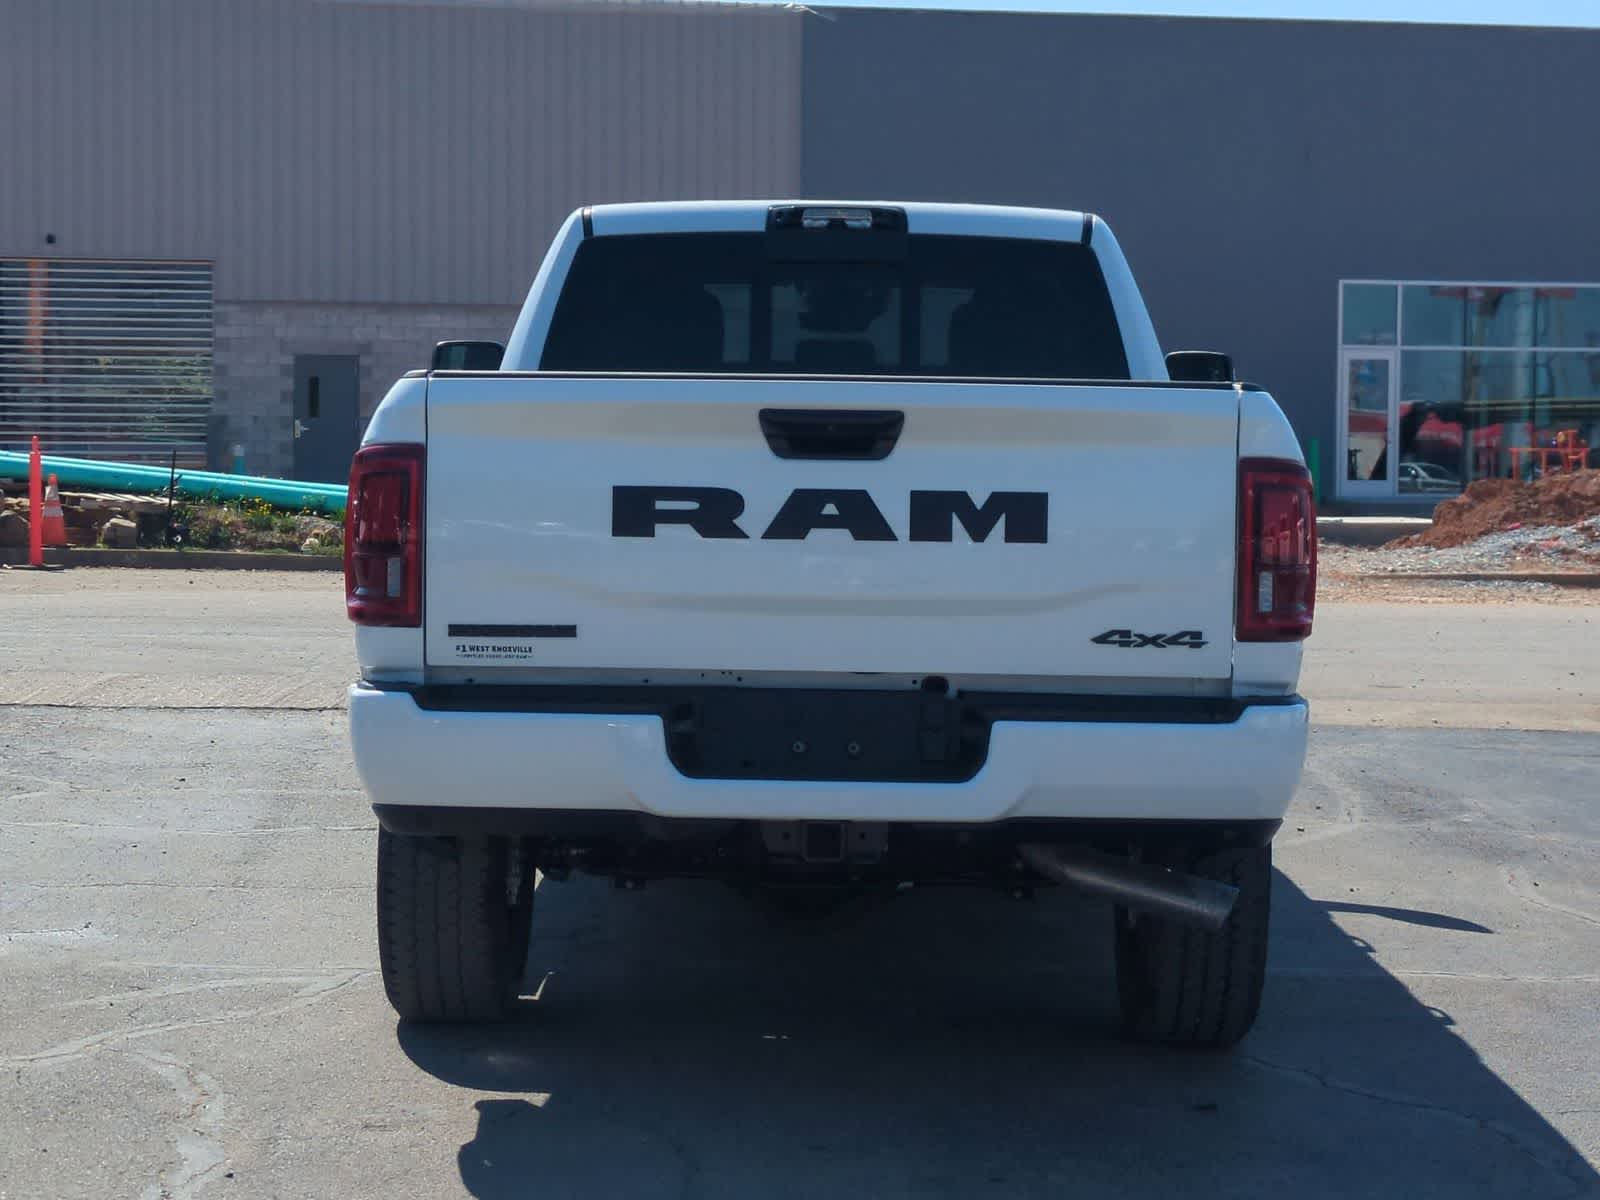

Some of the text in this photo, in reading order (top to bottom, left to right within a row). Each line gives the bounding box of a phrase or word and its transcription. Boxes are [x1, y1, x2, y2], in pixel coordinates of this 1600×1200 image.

[612, 485, 1049, 544] RAM
[1090, 629, 1209, 649] 4x4
[468, 645, 490, 653] WEST
[491, 645, 533, 654] KNOXVILLE
